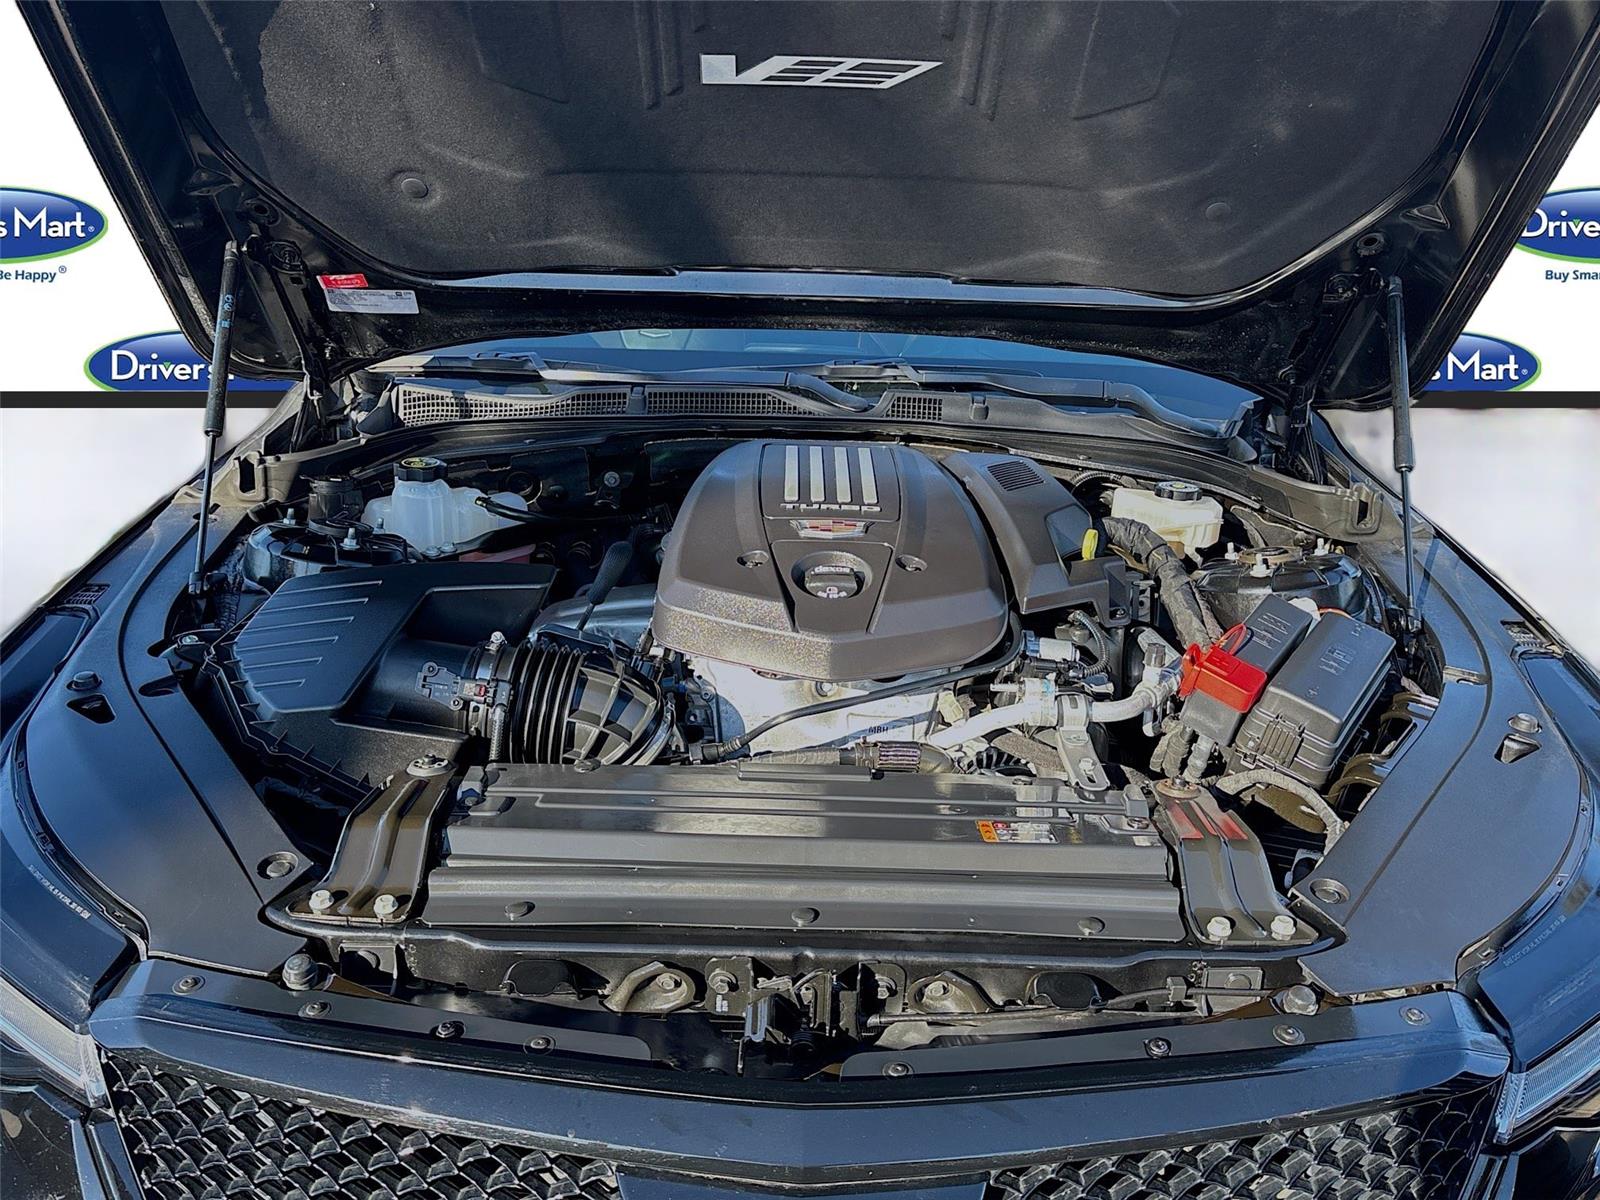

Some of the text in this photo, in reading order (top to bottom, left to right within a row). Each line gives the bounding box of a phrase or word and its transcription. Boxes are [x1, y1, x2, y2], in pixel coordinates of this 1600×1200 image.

[14, 206, 86, 237] Mart
[15, 269, 57, 283] Happy
[1545, 269, 1600, 283] Buy Sma
[1447, 349, 1519, 380] Mart
